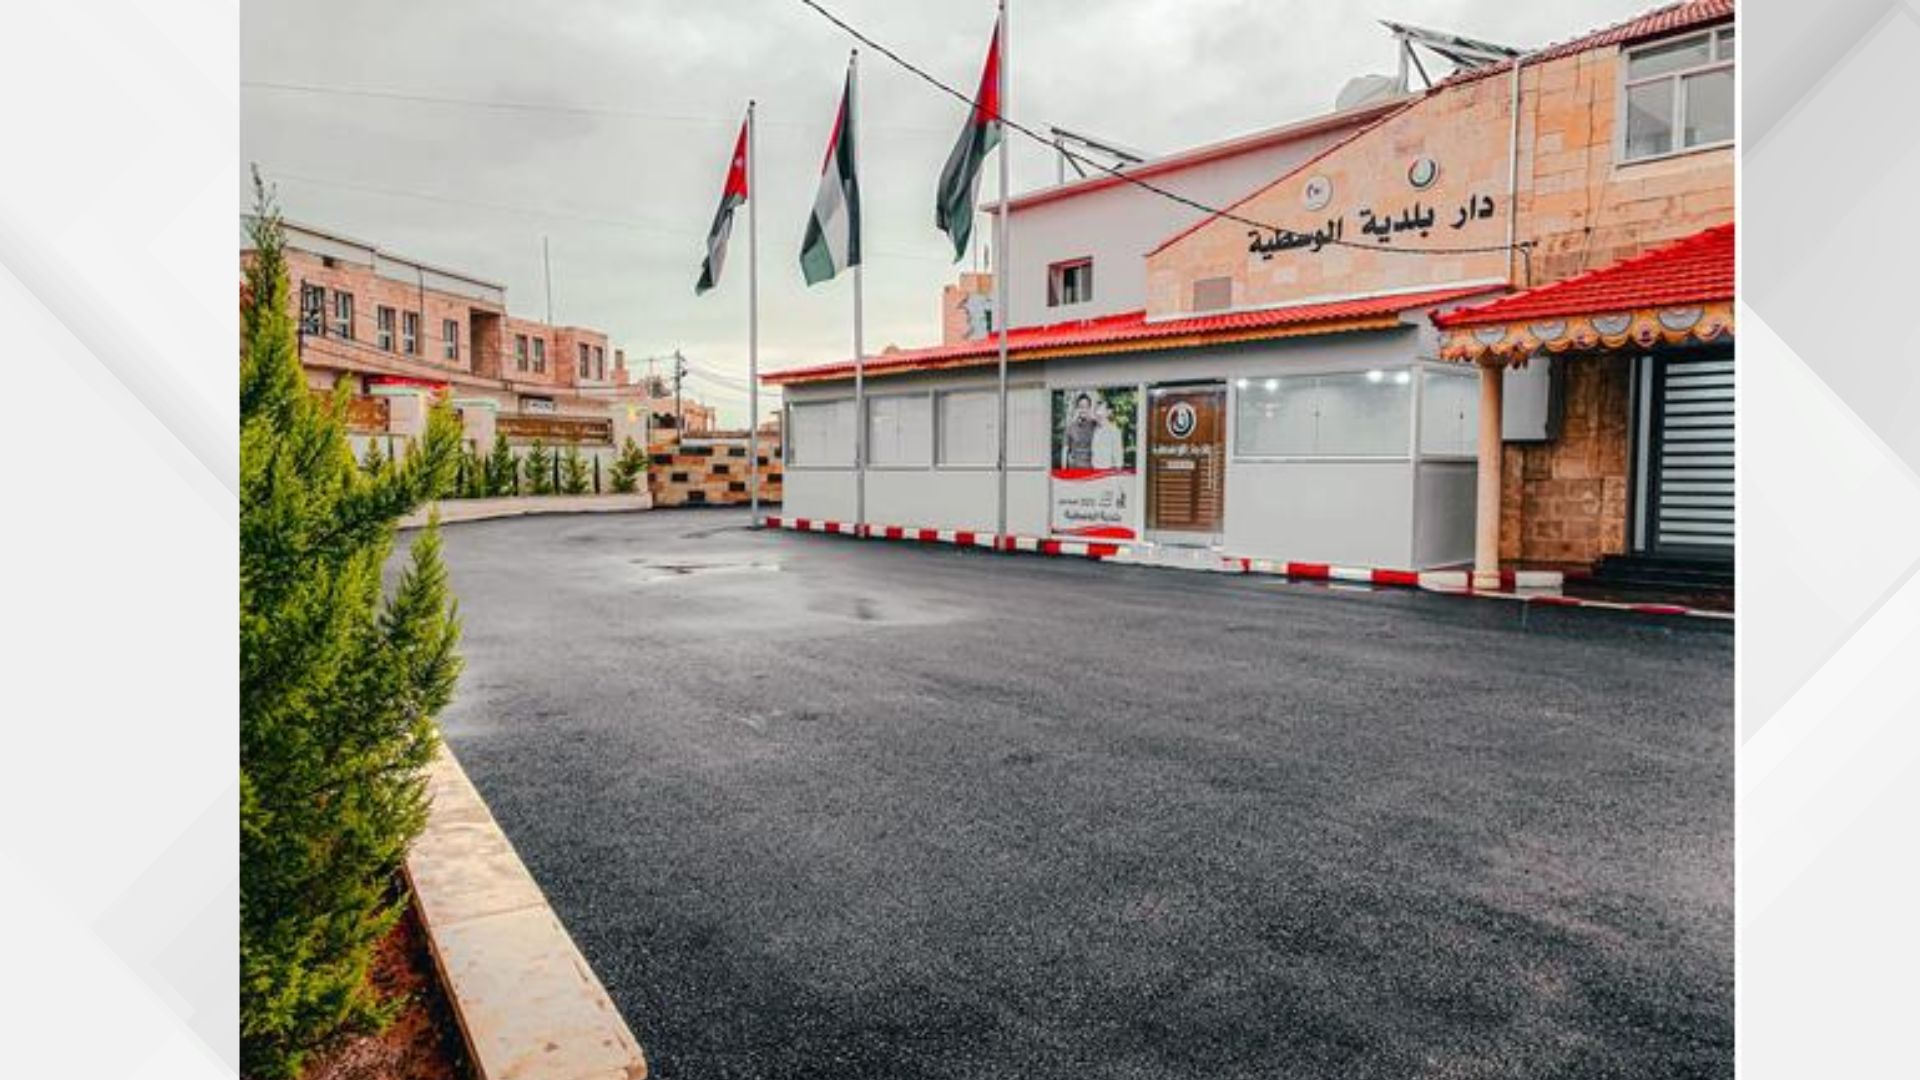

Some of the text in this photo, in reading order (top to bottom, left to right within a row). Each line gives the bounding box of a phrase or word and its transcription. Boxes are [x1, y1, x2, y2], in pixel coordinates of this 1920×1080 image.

[1248, 195, 1494, 260] دار بلدية الوسطية
